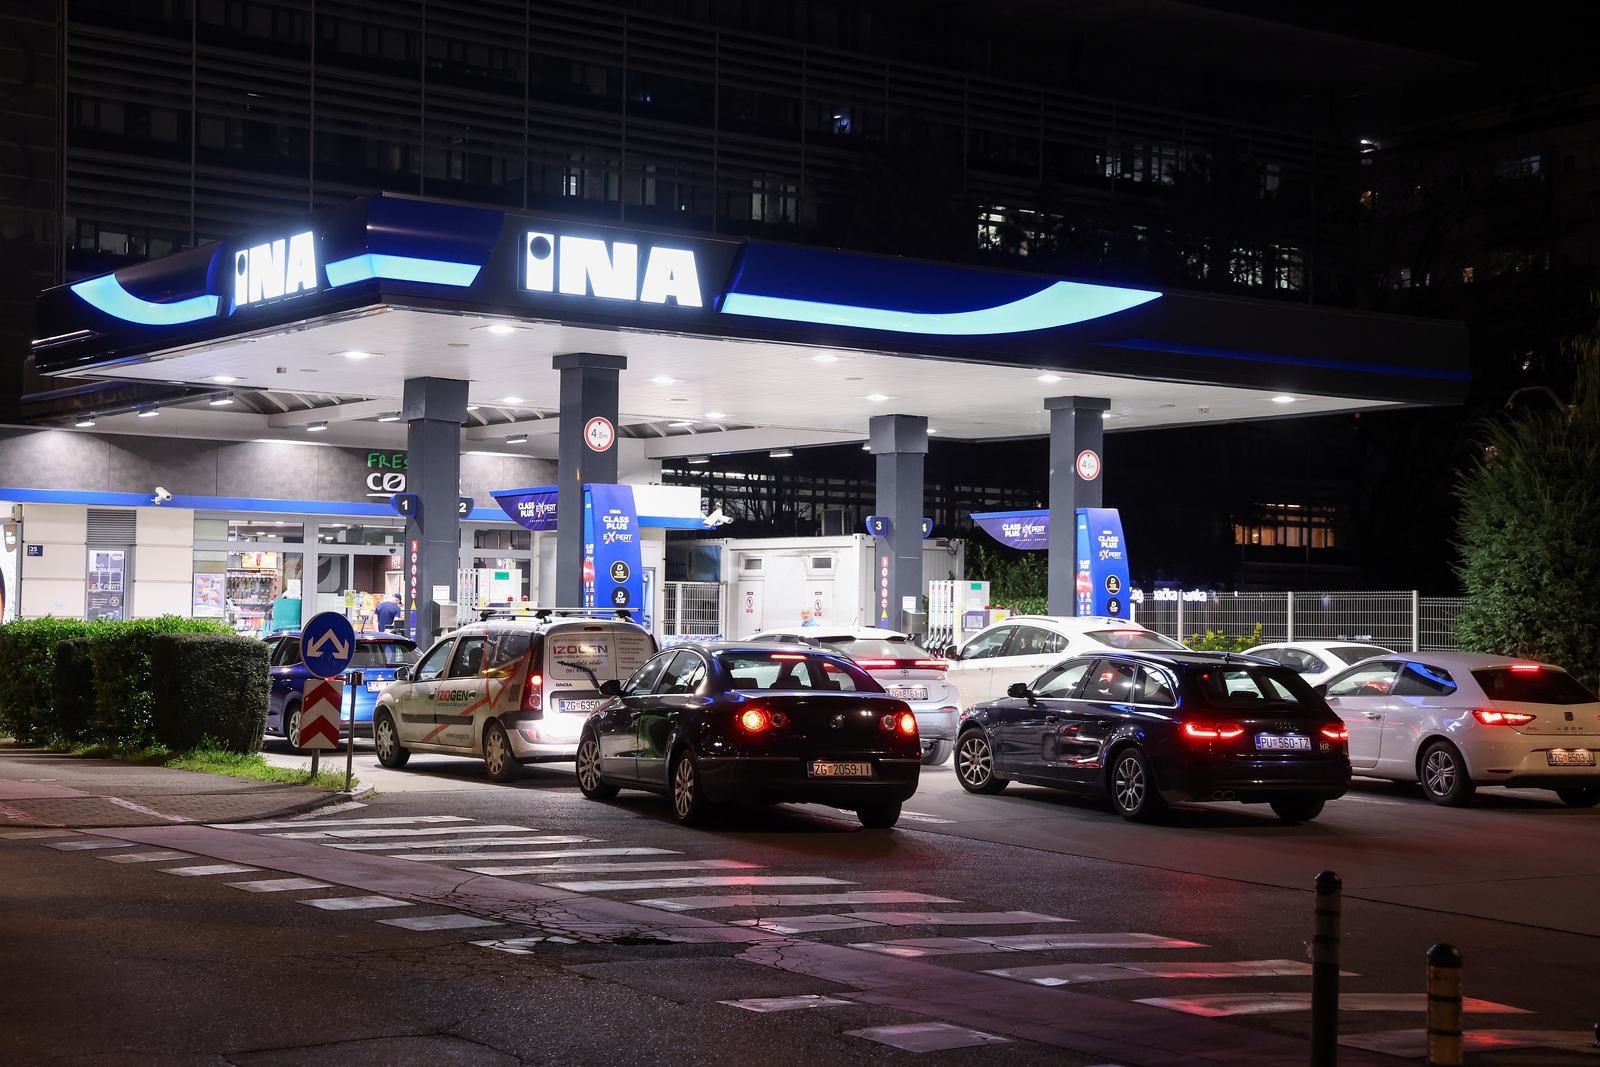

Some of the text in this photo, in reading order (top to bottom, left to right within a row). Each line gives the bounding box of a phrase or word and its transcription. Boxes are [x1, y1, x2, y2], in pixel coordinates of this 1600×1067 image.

[402, 500, 408, 510] 1
[459, 503, 467, 512] 2
[518, 502, 535, 510] CLASS
[520, 509, 535, 518] PLUS
[602, 515, 629, 523] CLASS
[875, 521, 882, 531] 3
[436, 690, 469, 701] IZOGEN
[565, 701, 576, 709] ZG
[1261, 738, 1273, 748] PU
[1320, 742, 1329, 750] HR
[1553, 753, 1563, 762] ZG
[815, 764, 827, 775] ZG
